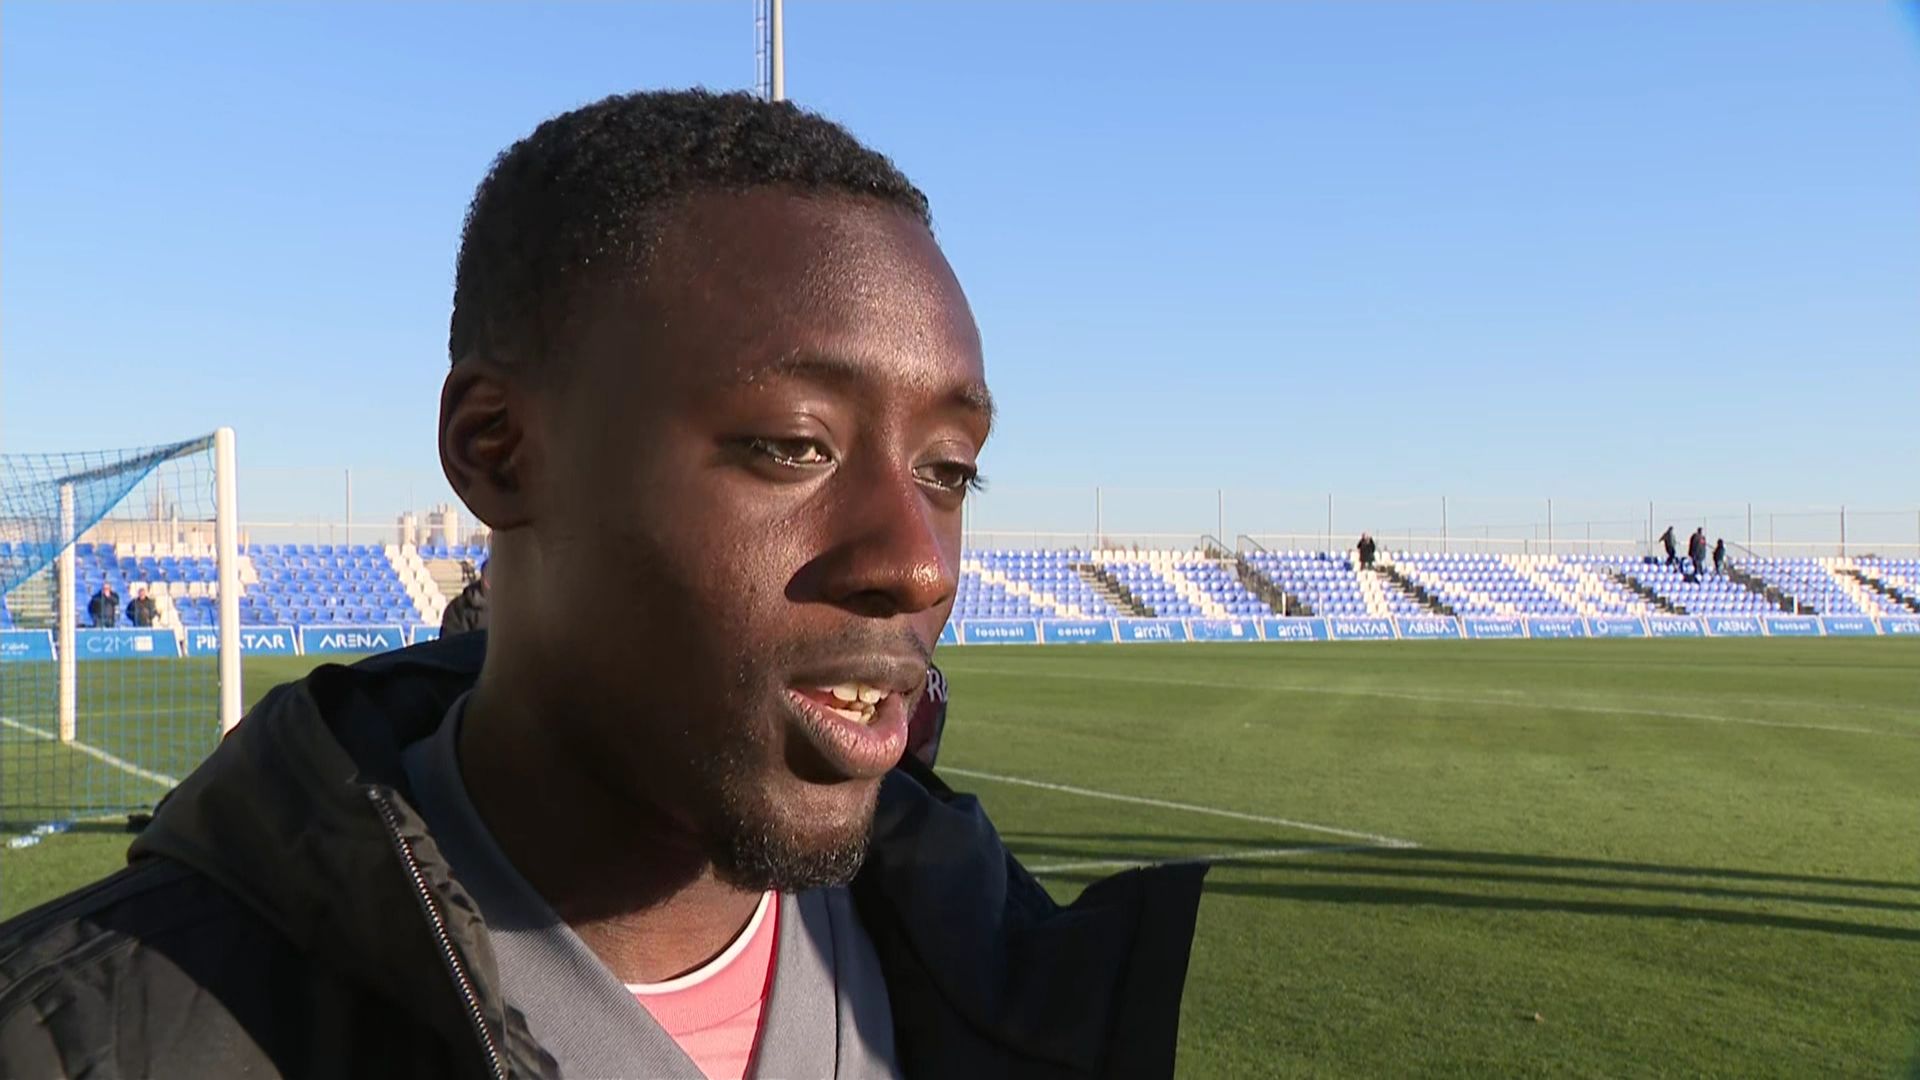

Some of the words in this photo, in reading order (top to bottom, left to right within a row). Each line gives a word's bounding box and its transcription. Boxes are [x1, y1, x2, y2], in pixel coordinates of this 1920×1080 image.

[975, 627, 1024, 637] football
[1057, 627, 1096, 636] center
[1336, 622, 1389, 635] PINATAR
[1408, 623, 1450, 634] ARENA
[1473, 623, 1513, 633] football
[320, 634, 388, 648] ARENA
